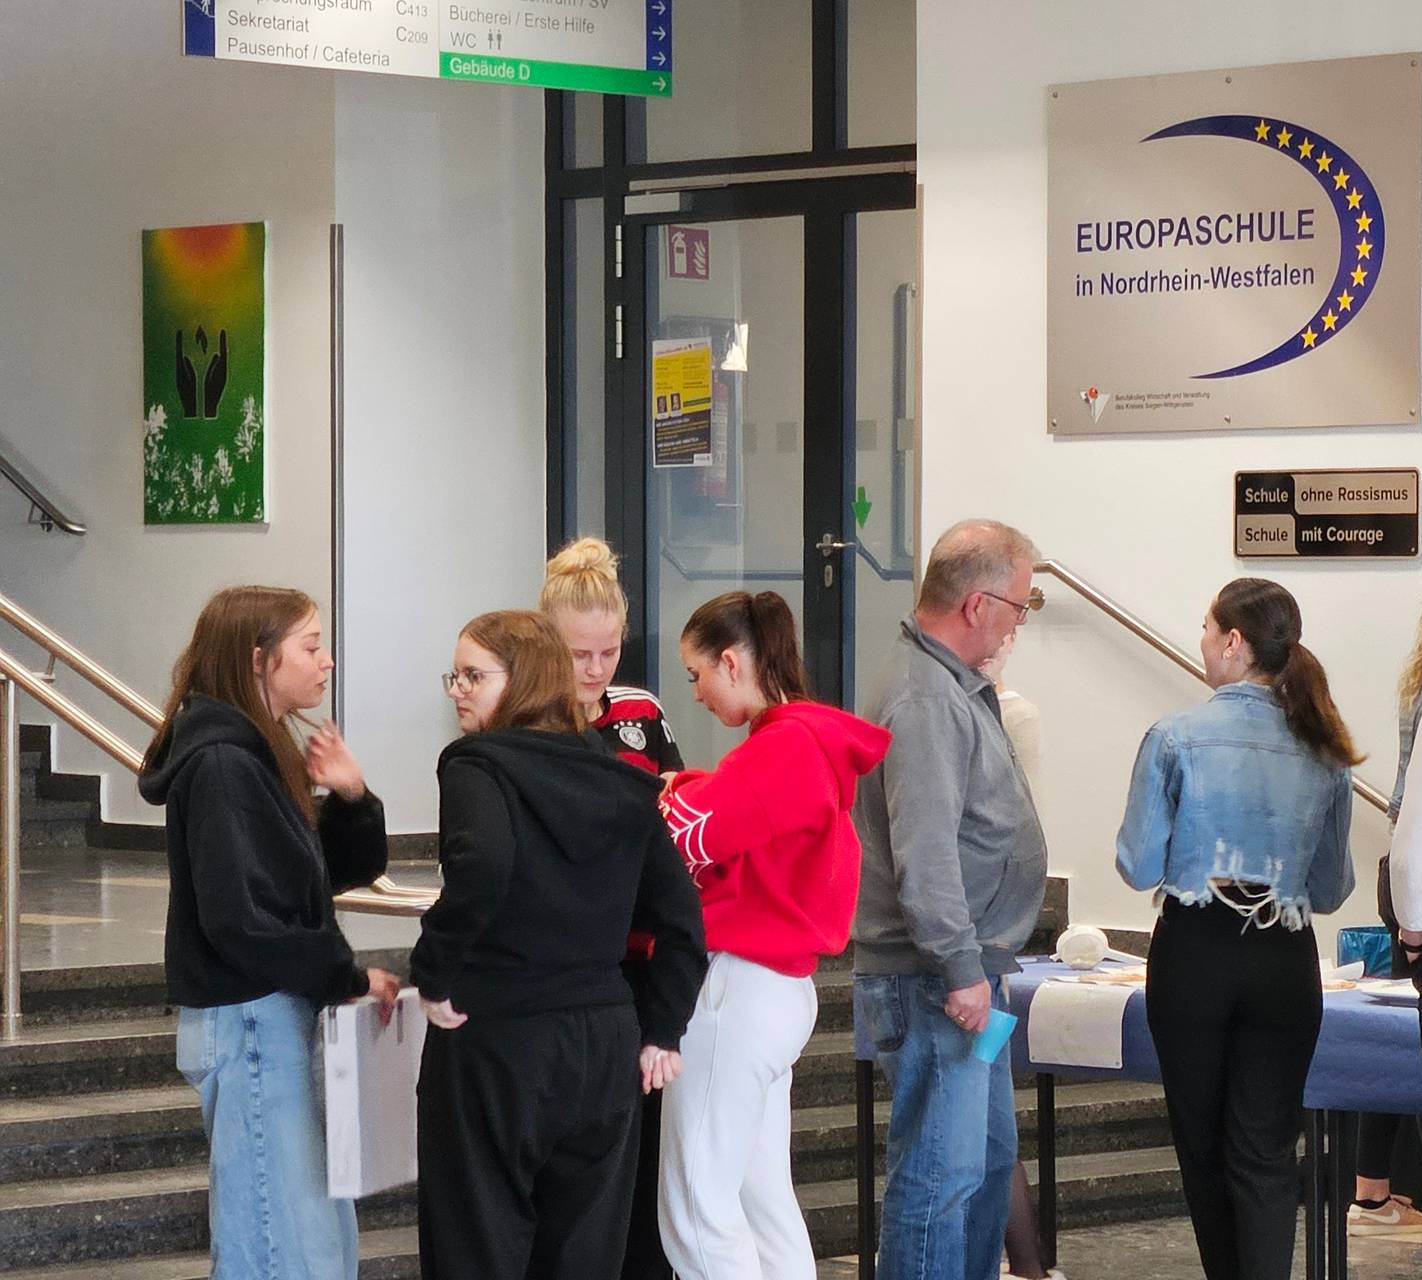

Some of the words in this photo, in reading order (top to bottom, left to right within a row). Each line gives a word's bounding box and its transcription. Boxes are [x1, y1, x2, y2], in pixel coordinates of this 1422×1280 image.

[396, 1, 428, 17] C413
[449, 5, 511, 26] Bücherei
[524, 13, 560, 30] Erste
[564, 16, 595, 34] Hilfe
[227, 10, 310, 33] Sekretariat
[396, 26, 428, 44] C209
[450, 32, 477, 49] WC
[227, 37, 309, 60] Pausenhof
[322, 46, 390, 66] Cafeteria
[450, 58, 514, 78] Gebäude
[519, 64, 531, 80] D
[1076, 208, 1315, 254] EUROPASCHULE
[1076, 274, 1093, 297] in
[1100, 263, 1315, 296] Nordrhein-Westfalen
[1245, 487, 1289, 503] Schule
[1301, 488, 1333, 502] ohne
[1338, 486, 1409, 502] Rassismus
[1245, 527, 1288, 542] Schule
[1301, 526, 1323, 542] mit
[1326, 526, 1384, 545] Courage
